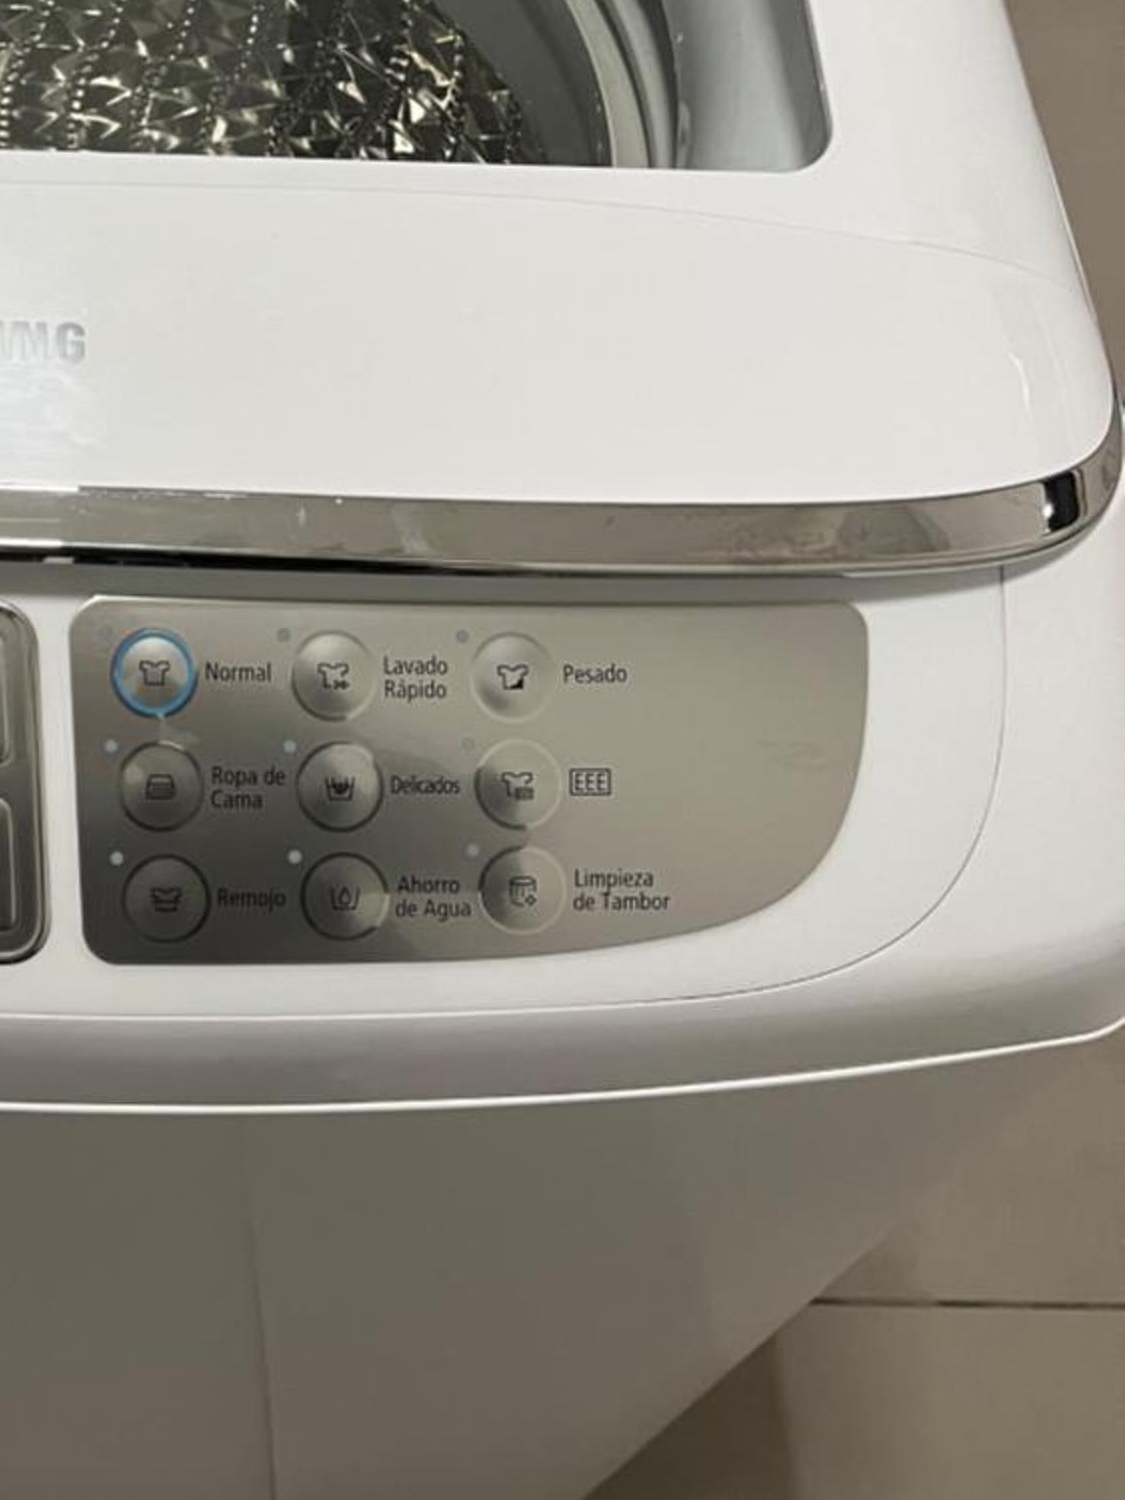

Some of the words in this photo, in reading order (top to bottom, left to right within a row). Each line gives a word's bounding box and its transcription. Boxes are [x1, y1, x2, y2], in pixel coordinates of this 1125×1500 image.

[204, 663, 272, 682] Normal
[383, 655, 448, 676] Lavado
[563, 664, 627, 683] Pesado
[384, 678, 447, 702] Rápido
[212, 766, 257, 789] Ropa
[263, 767, 286, 785] de
[390, 776, 460, 795] Delicados
[575, 773, 607, 791] EEE
[211, 790, 263, 808] Cama
[398, 876, 460, 895] Ahorro
[575, 868, 654, 890] Limpieza
[218, 889, 286, 912] Remojo
[573, 893, 595, 910] de
[601, 893, 671, 911] Tambor
[395, 899, 417, 917] de
[423, 901, 472, 923] Agua
